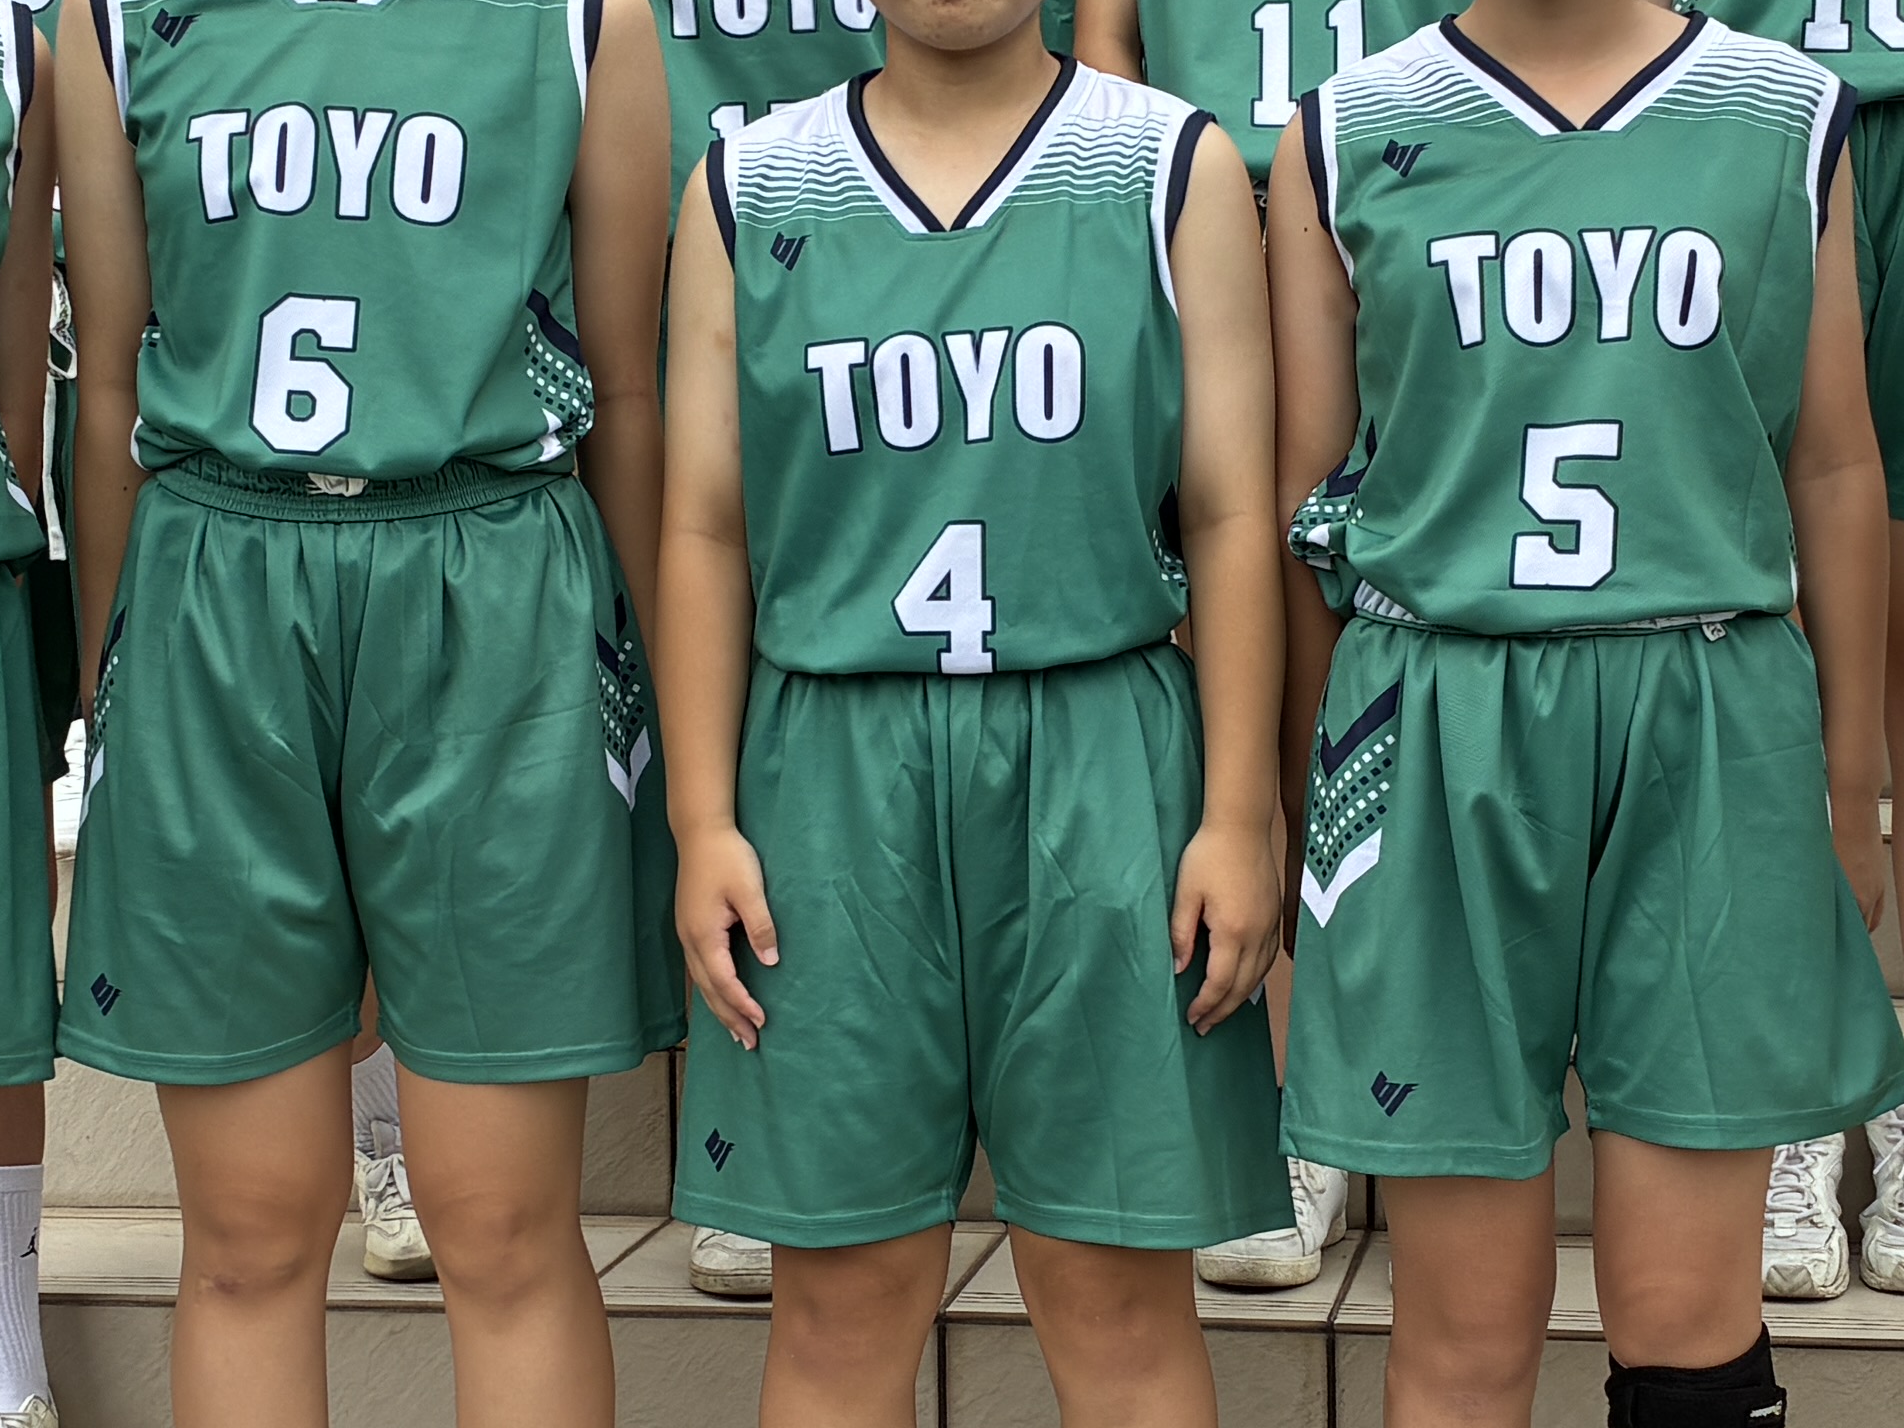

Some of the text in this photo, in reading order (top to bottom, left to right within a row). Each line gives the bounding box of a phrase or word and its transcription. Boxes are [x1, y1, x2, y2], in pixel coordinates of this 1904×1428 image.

[185, 100, 468, 226] TOYO
[1427, 224, 1726, 352] TOYO
[249, 292, 361, 456] 6
[803, 321, 1086, 458] TOYO
[1508, 418, 1623, 591] 5
[891, 519, 997, 675] 4
